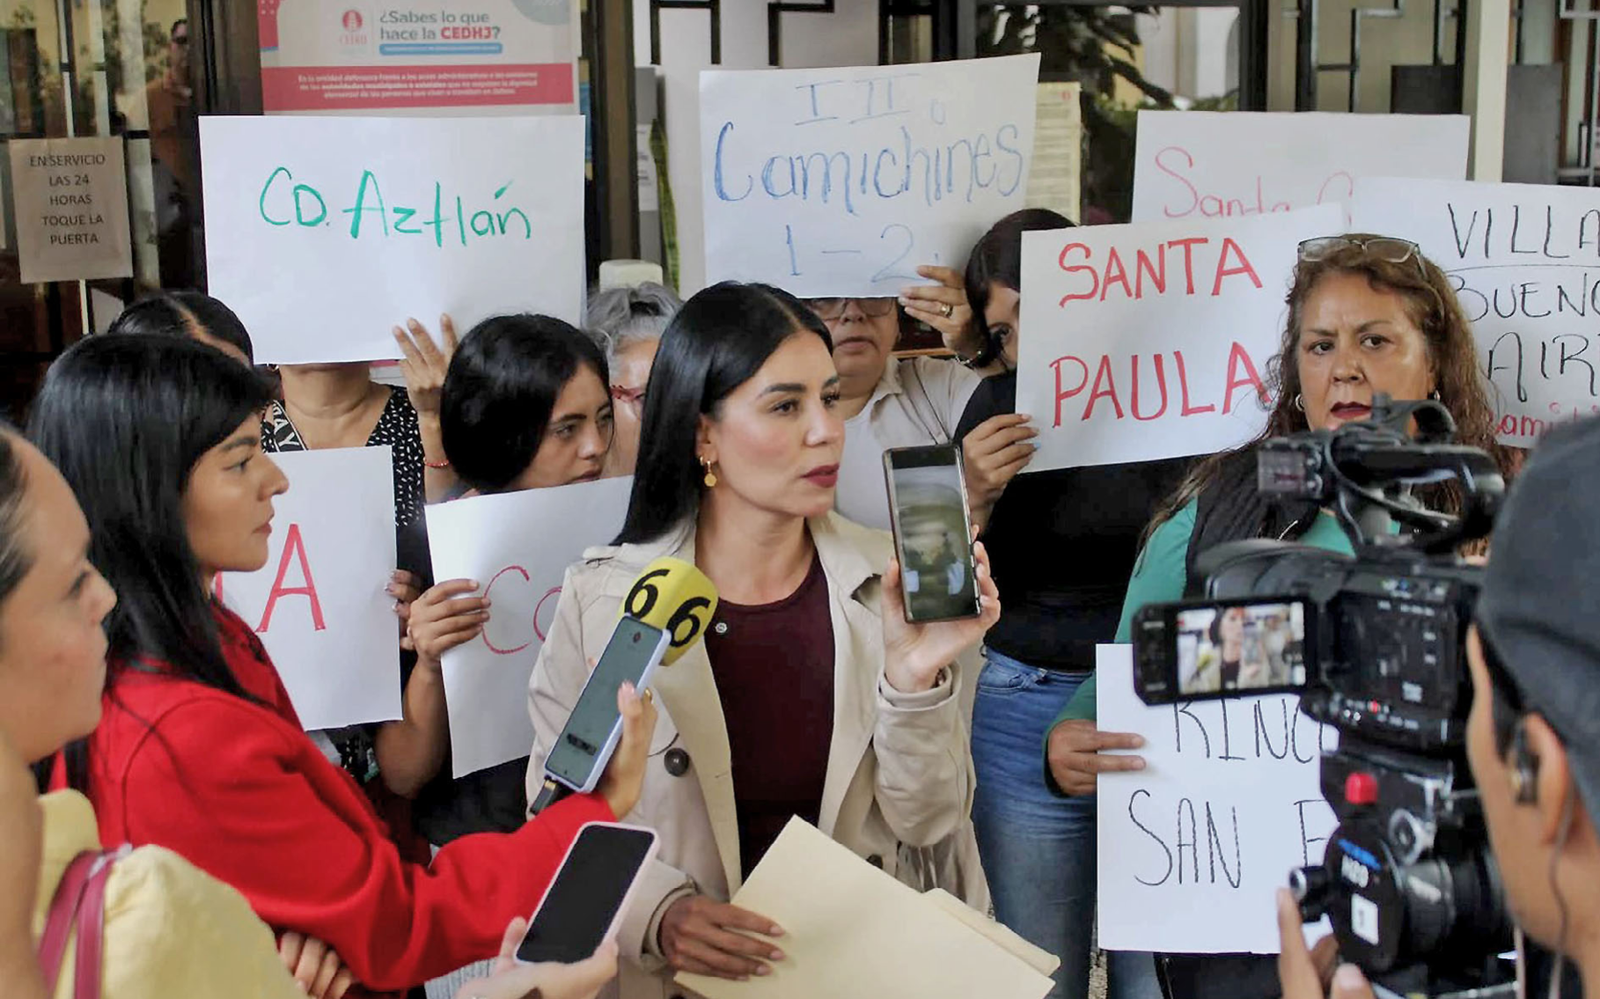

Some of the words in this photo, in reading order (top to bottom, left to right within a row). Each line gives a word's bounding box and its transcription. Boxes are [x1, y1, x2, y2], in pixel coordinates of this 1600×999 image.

[379, 10, 438, 24] ¿Sabes
[441, 11, 456, 23] lo
[460, 12, 490, 25] que
[380, 27, 419, 40] hace
[423, 27, 437, 40] la
[440, 26, 501, 40] CEDHJ?
[30, 156, 47, 167] EN
[48, 154, 106, 166] SERVICIO
[49, 176, 71, 187] LAS
[74, 173, 89, 186] 24
[714, 121, 1023, 216] Camichines
[42, 215, 87, 227] TOQUE
[89, 214, 104, 225] LA
[50, 194, 93, 206] HORAS
[260, 167, 330, 227] CD.
[342, 169, 532, 249] Aztlán
[50, 233, 99, 245] PUERTA
[1448, 203, 1600, 258] VILLA
[1059, 237, 1264, 308] SANTA
[1050, 341, 1273, 429] PAULA
[1487, 331, 1600, 403] AIR
[624, 568, 671, 621] 6
[666, 596, 712, 648] 6
[1173, 696, 1326, 764] RINC
[1128, 789, 1241, 889] SAN
